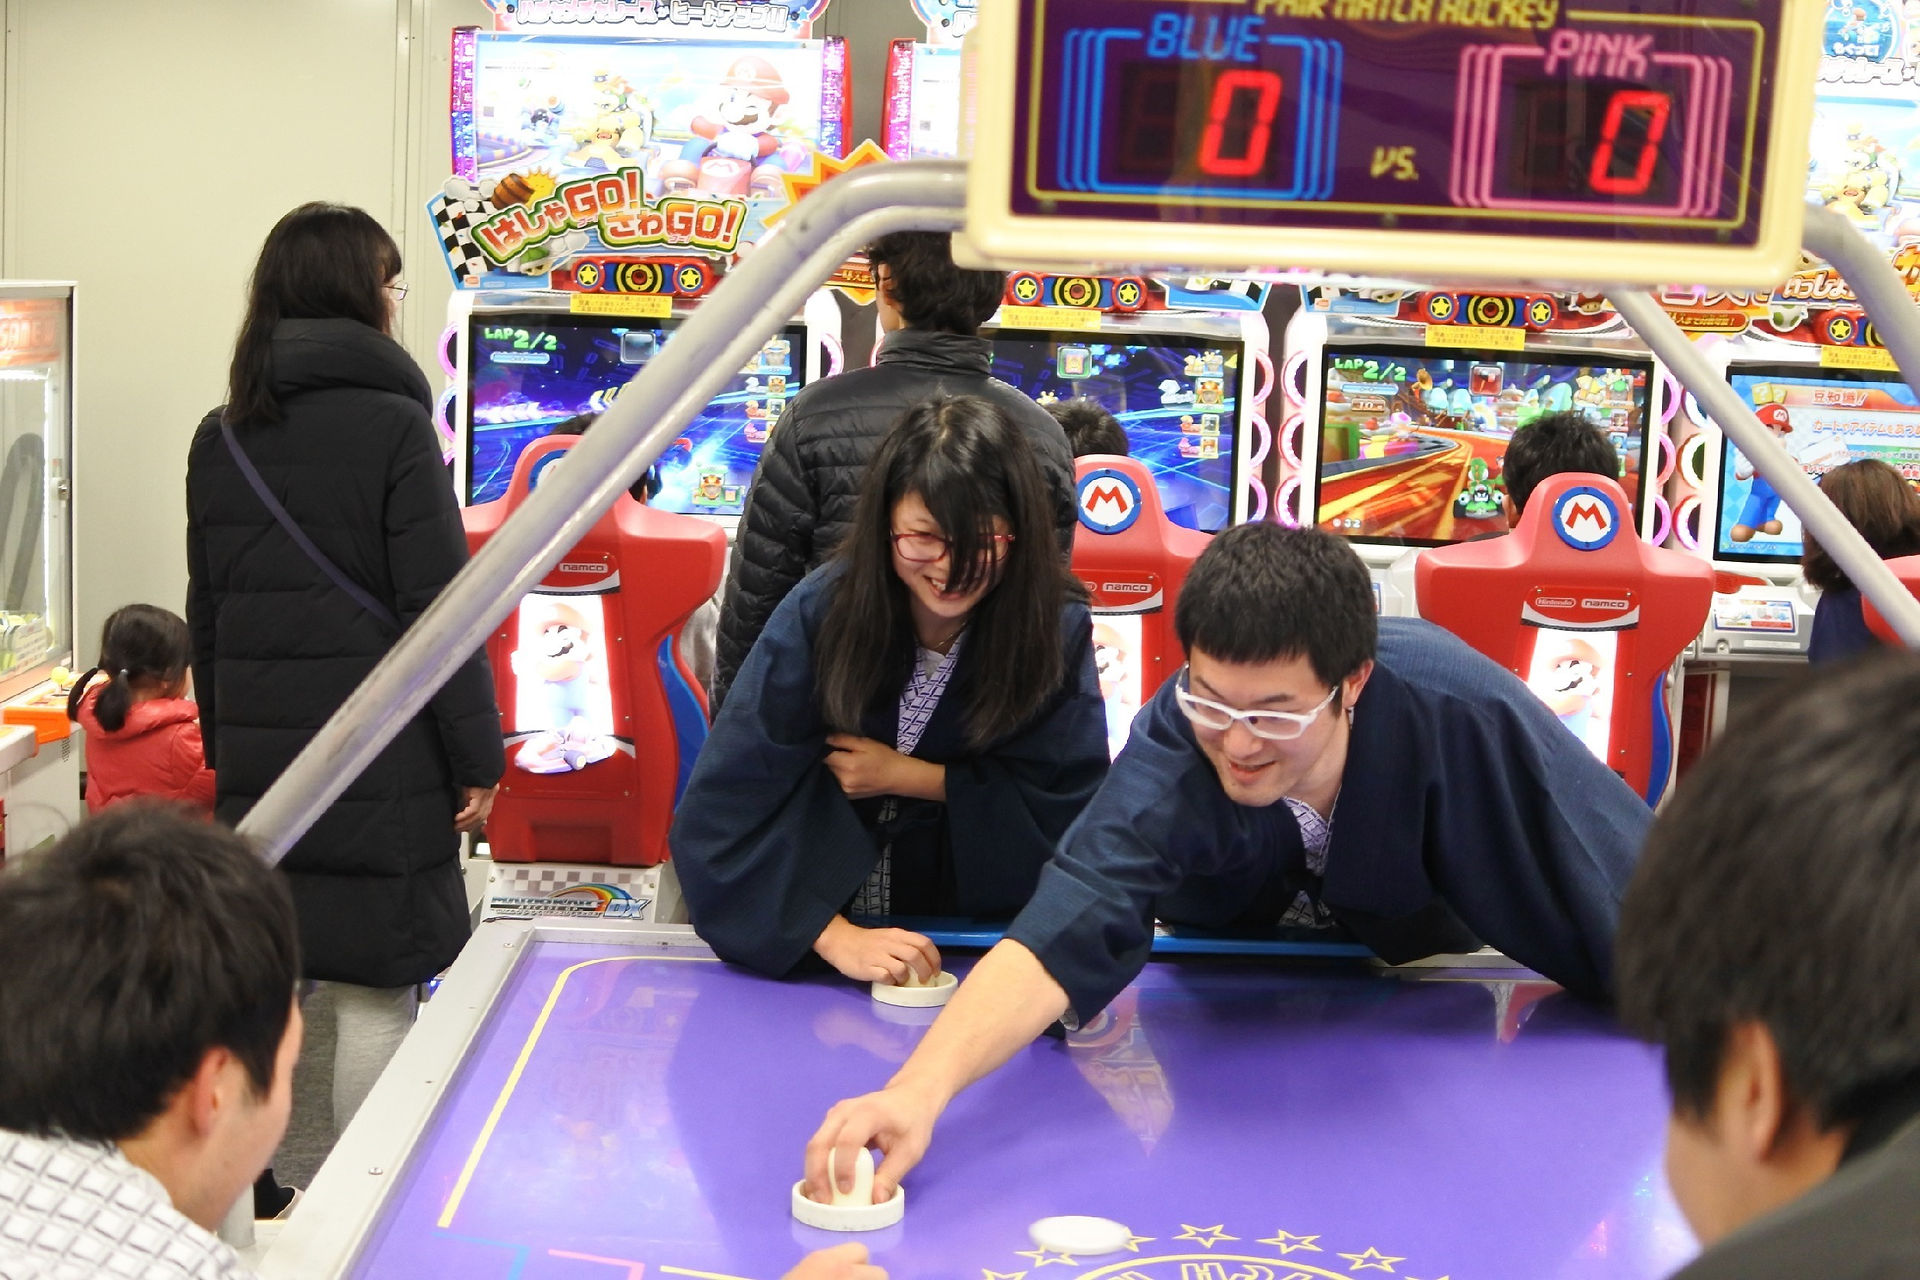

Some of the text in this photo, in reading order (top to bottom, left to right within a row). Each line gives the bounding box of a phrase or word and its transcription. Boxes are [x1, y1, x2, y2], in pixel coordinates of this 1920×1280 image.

[1437, 0, 1558, 29] HOCKEY
[1147, 13, 1265, 61] BLUE
[1545, 29, 1654, 78] PINK
[1197, 69, 1282, 176] 0
[1589, 90, 1671, 195] 0
[480, 169, 640, 252] はしゃGO!
[606, 200, 738, 245] さわGO!
[484, 326, 557, 351] LAP 2/2
[1334, 357, 1406, 381] LAP 2/2
[562, 563, 606, 573] namco
[1104, 582, 1149, 593] namco
[1583, 599, 1627, 609] namco
[604, 898, 652, 920] DX
